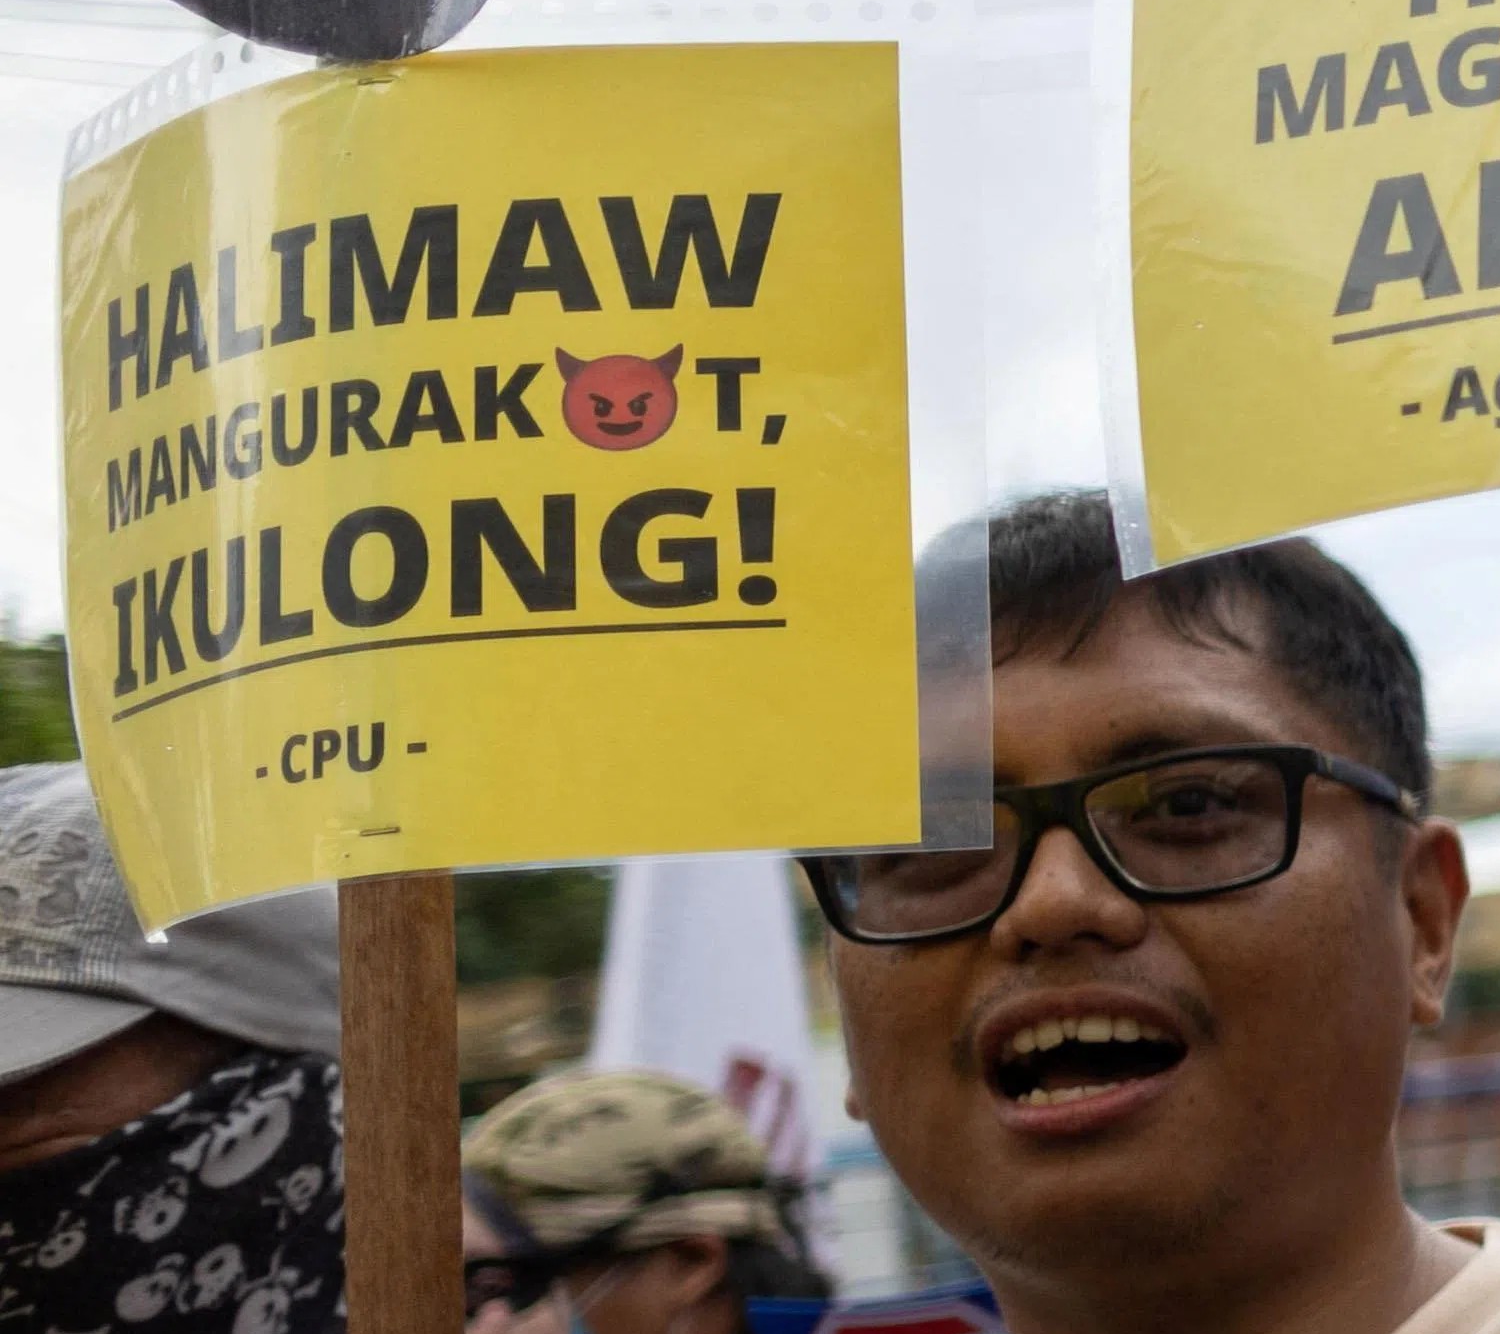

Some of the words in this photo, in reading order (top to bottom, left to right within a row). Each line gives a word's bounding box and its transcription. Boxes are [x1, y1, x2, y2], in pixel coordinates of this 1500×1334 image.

[107, 192, 783, 412] HALIMAW
[111, 487, 780, 699] IKULONG!
[280, 722, 386, 784] CPU
